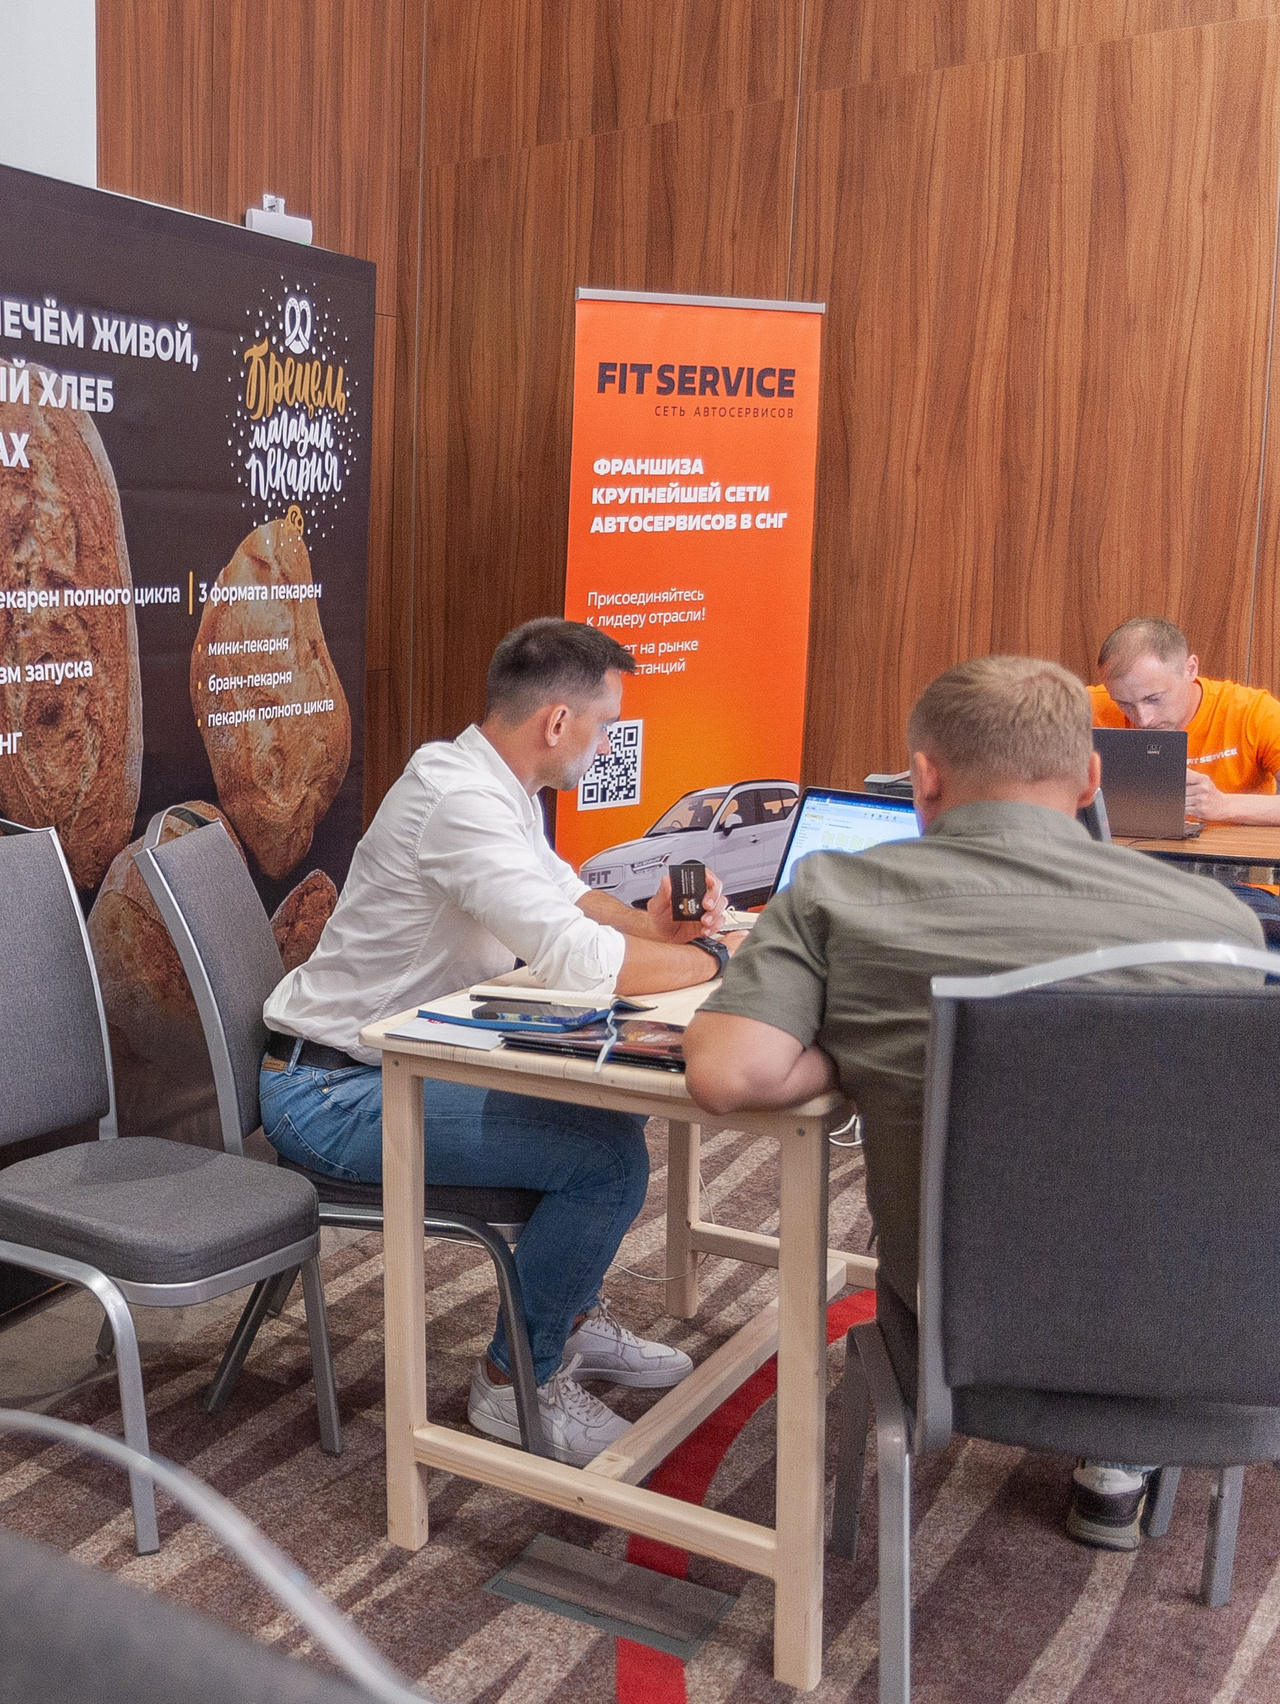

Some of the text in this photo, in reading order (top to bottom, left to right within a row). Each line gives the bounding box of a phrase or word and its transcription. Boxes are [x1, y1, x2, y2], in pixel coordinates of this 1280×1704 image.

[92, 316, 198, 371] ЖИВОЙ,
[243, 337, 346, 420] Брецель
[656, 364, 796, 398] SERVICE
[38, 370, 114, 413] ХЛЕБ
[654, 405, 794, 418] СЕТЬ АВТОСЕРВИСОВ
[249, 411, 334, 457] магазин
[245, 448, 342, 501] пекарня
[593, 458, 704, 476] ФРАНШИЗА
[591, 482, 770, 504] КРУПНЕЙШЕЙ СЕТИ
[590, 512, 788, 534] АВТОСЕРВИСОВ В СНГ
[64, 588, 131, 607] полного
[135, 587, 180, 607] цикла
[198, 582, 322, 606] 3 формата пекарен
[587, 587, 704, 609] Присоединяйтесь
[586, 607, 705, 628] к лидеру отрасли!
[208, 637, 289, 656] мини-пекарня
[640, 643, 655, 654] на
[658, 640, 699, 656] рынке
[25, 660, 93, 685] запуска
[208, 671, 292, 695] бранч-пекарня
[208, 698, 334, 727] пекарня полного цикла
[1200, 748, 1238, 764] SERVICE
[588, 870, 611, 885] FIT
